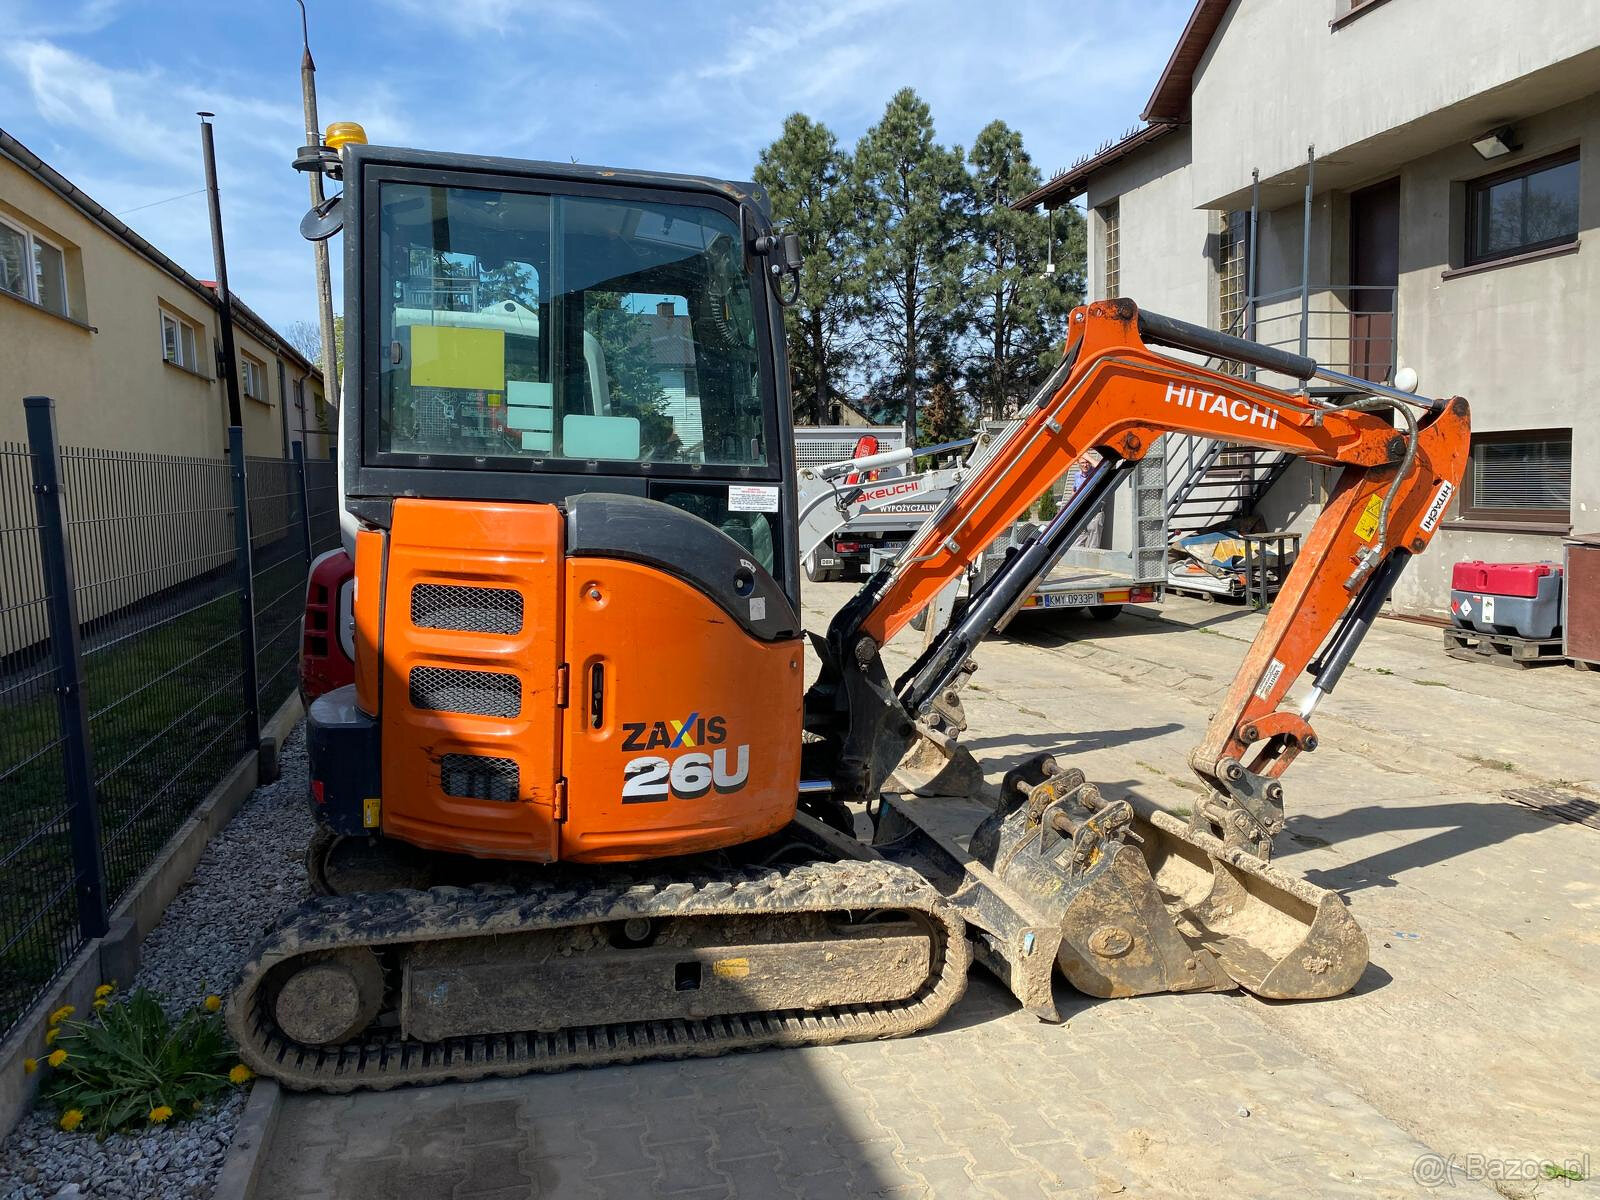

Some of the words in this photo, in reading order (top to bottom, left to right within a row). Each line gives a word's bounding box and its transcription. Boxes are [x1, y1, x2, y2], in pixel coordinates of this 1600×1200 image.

[1164, 381, 1279, 430] HITACHI
[1423, 484, 1452, 530] HITACHI
[1049, 595, 1066, 606] KMY
[1068, 594, 1094, 605] 0933P
[622, 712, 727, 752] ZAXIS
[622, 744, 750, 805] 26U
